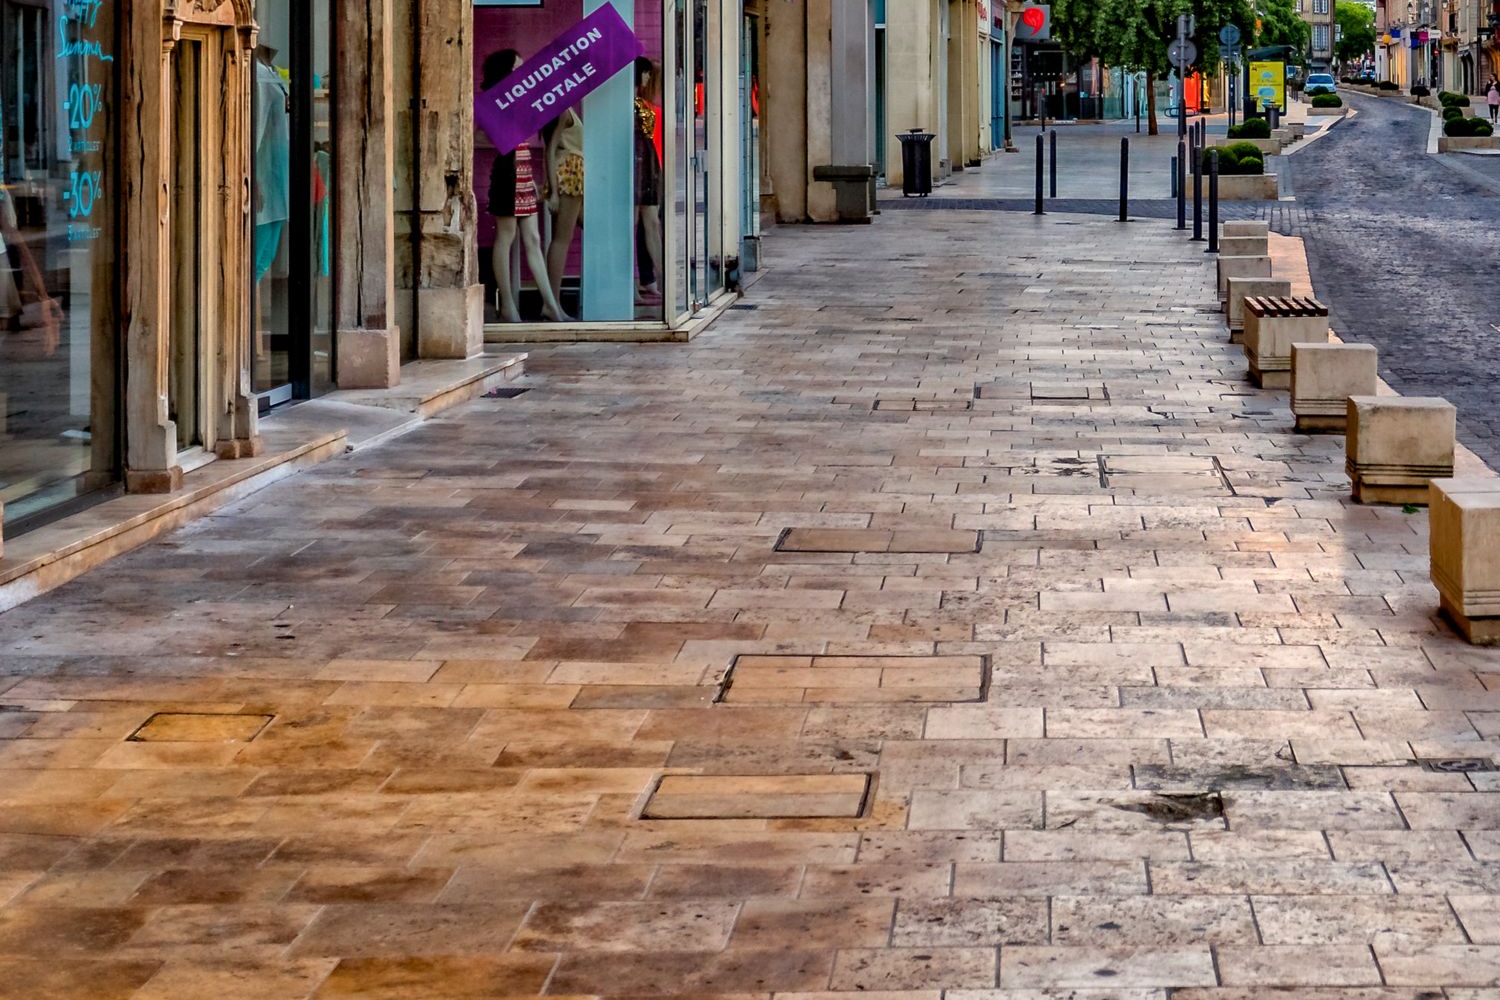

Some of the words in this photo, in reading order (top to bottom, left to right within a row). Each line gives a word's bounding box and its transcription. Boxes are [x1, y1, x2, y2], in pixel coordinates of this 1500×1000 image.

[56, 15, 114, 61] Summer
[495, 27, 602, 110] LIQUIDATION
[531, 62, 597, 112] TOTALE
